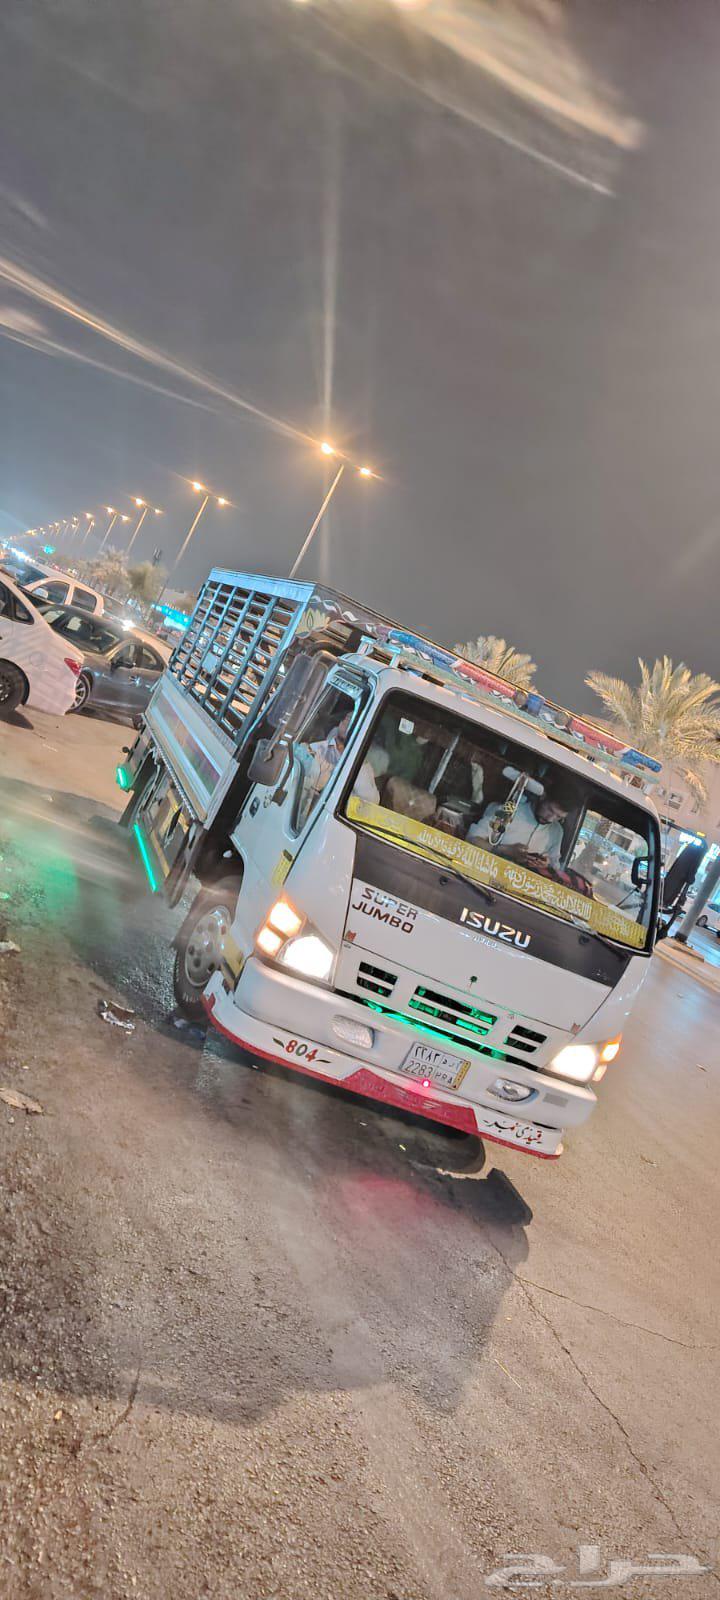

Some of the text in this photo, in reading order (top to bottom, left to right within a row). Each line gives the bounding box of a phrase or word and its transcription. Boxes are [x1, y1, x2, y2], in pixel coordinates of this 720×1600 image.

[352, 901, 414, 934] JUMBO
[362, 887, 419, 921] SUPER
[459, 907, 531, 949] ISUZU
[285, 1039, 319, 1062] 804
[404, 1060, 433, 1078] 2283
